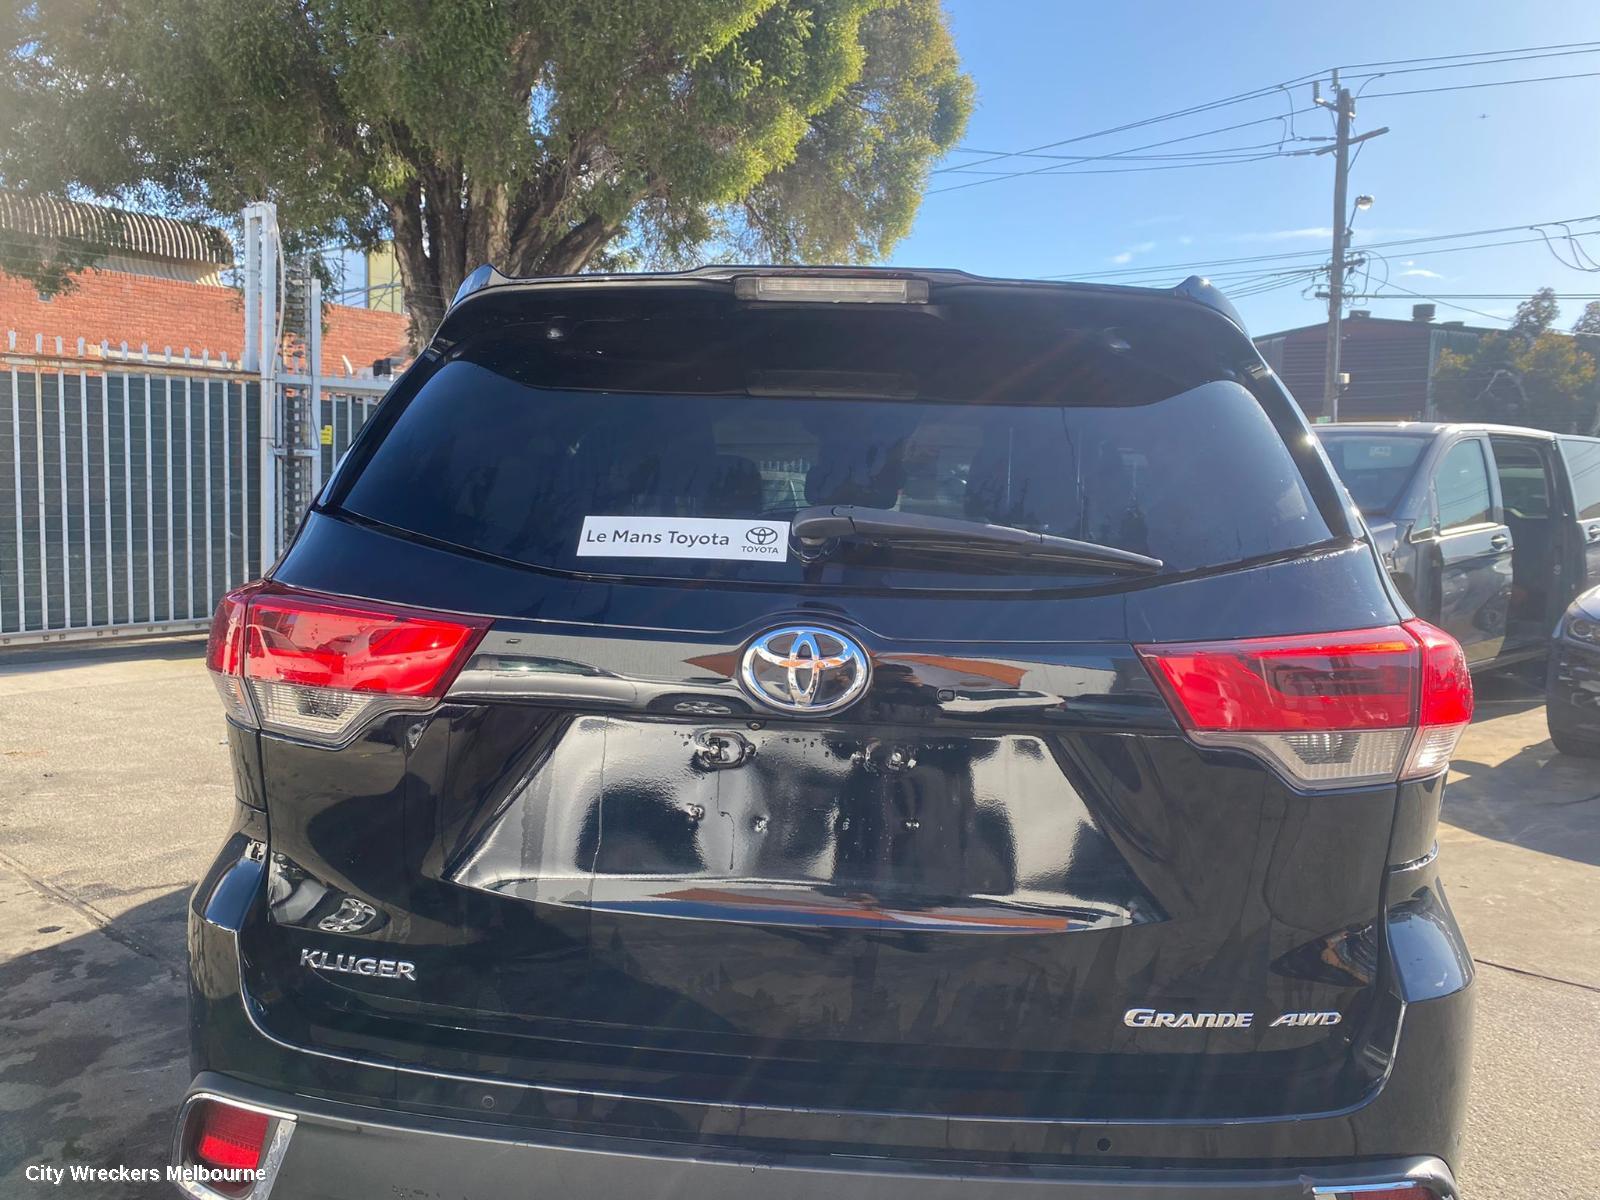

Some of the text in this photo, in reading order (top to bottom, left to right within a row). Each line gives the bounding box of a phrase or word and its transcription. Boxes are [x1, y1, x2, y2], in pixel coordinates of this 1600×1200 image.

[586, 529, 730, 548] Le Mans Toyota
[741, 545, 779, 554] TOYOTA
[300, 948, 416, 981] KLUGER
[1123, 1008, 1343, 1028] GRANDE AWD
